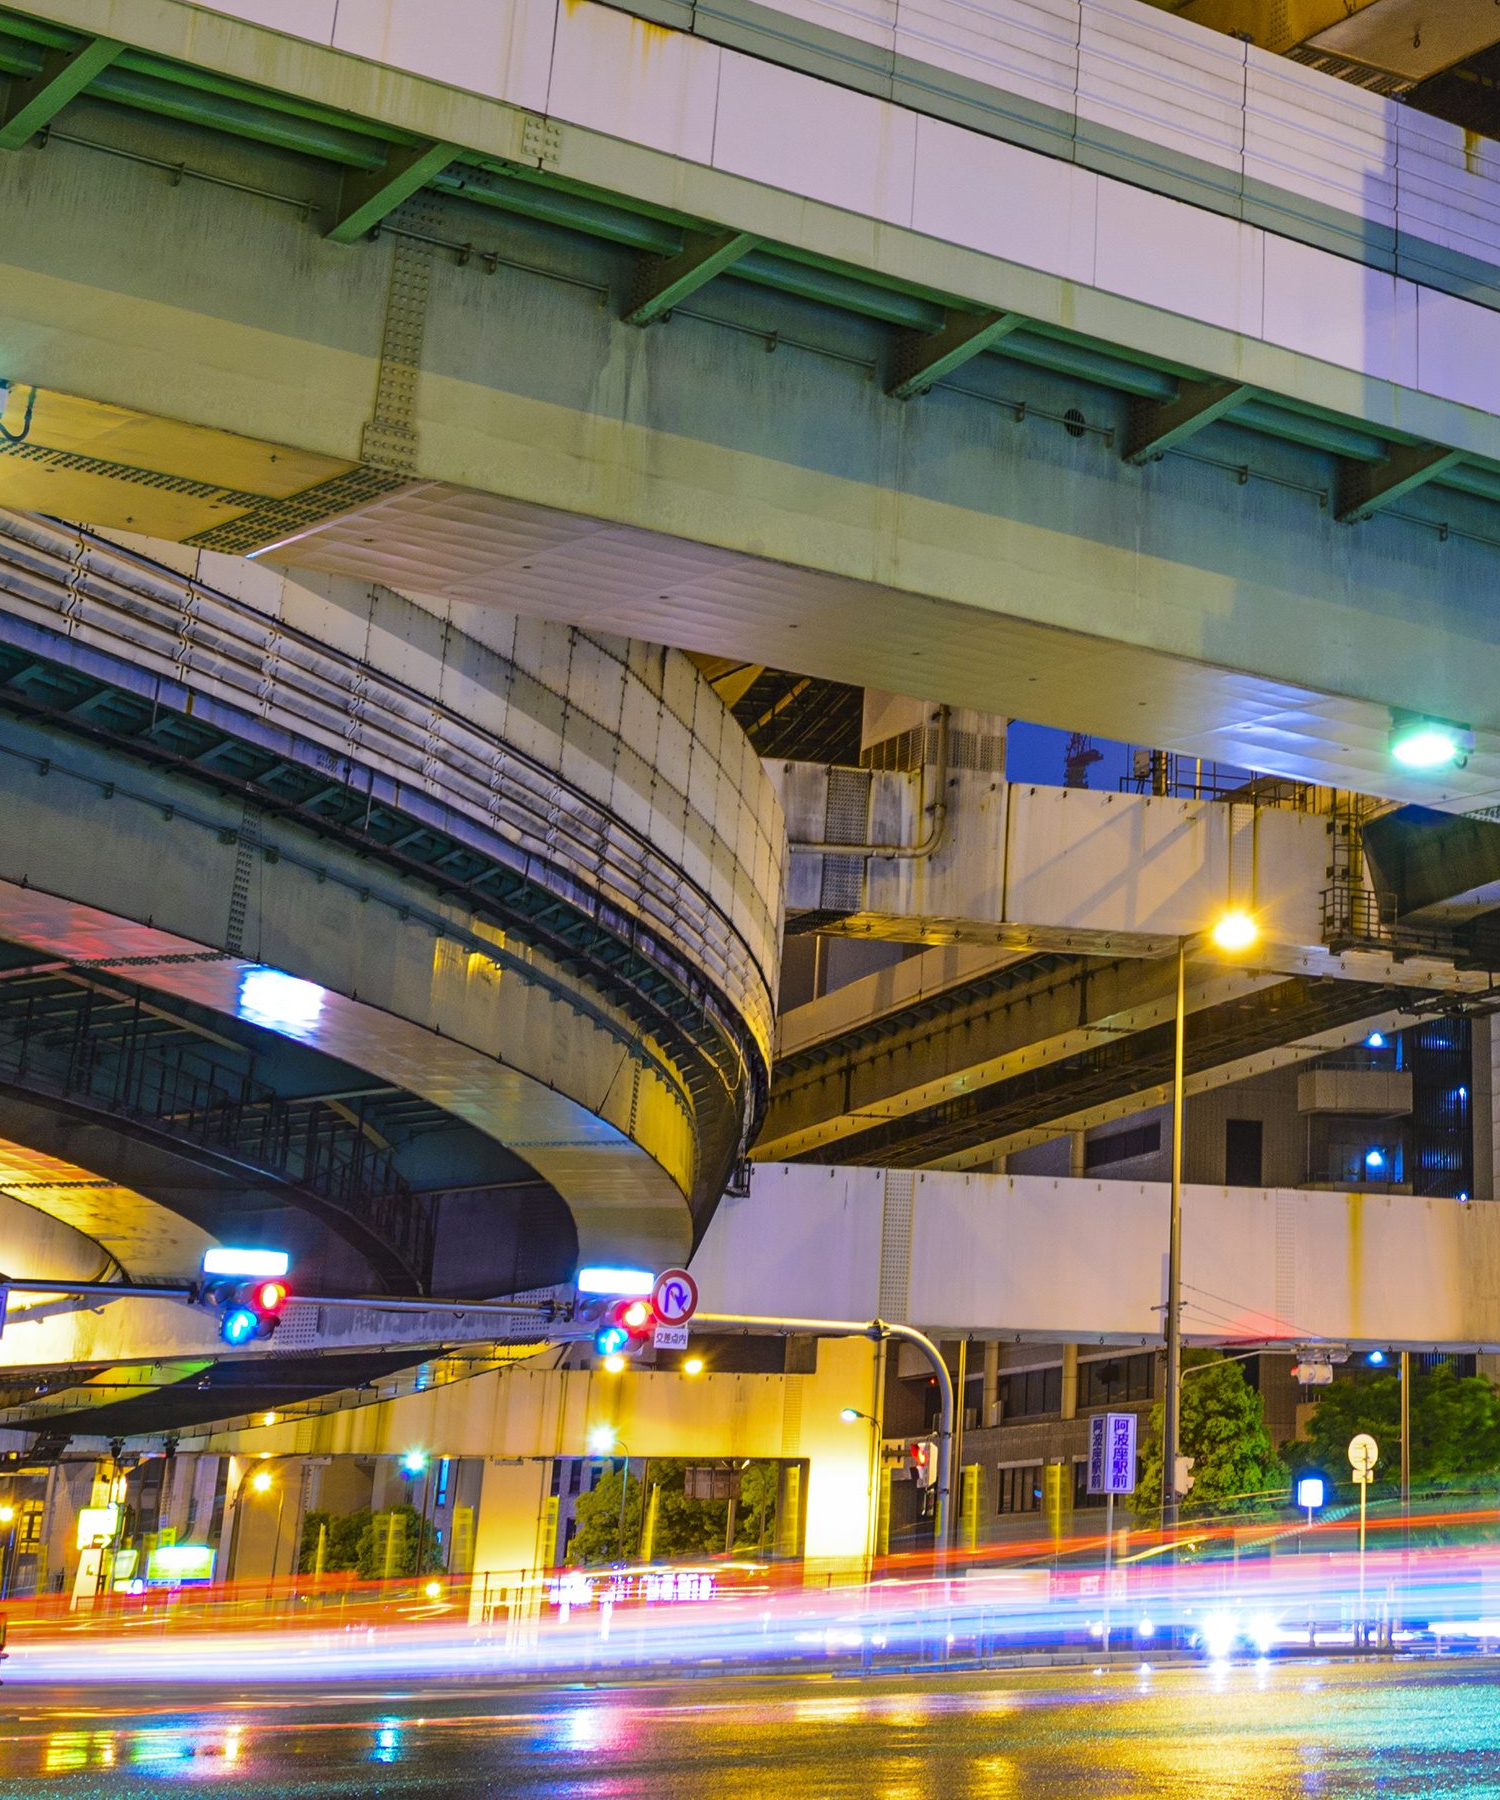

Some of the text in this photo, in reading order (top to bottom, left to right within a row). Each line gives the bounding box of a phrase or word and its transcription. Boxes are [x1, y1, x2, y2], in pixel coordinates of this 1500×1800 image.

[656, 1332, 687, 1345] 交差点内
[1091, 1419, 1104, 1489] 阿波座駅前
[1112, 1419, 1130, 1489] 阿波座駅前
